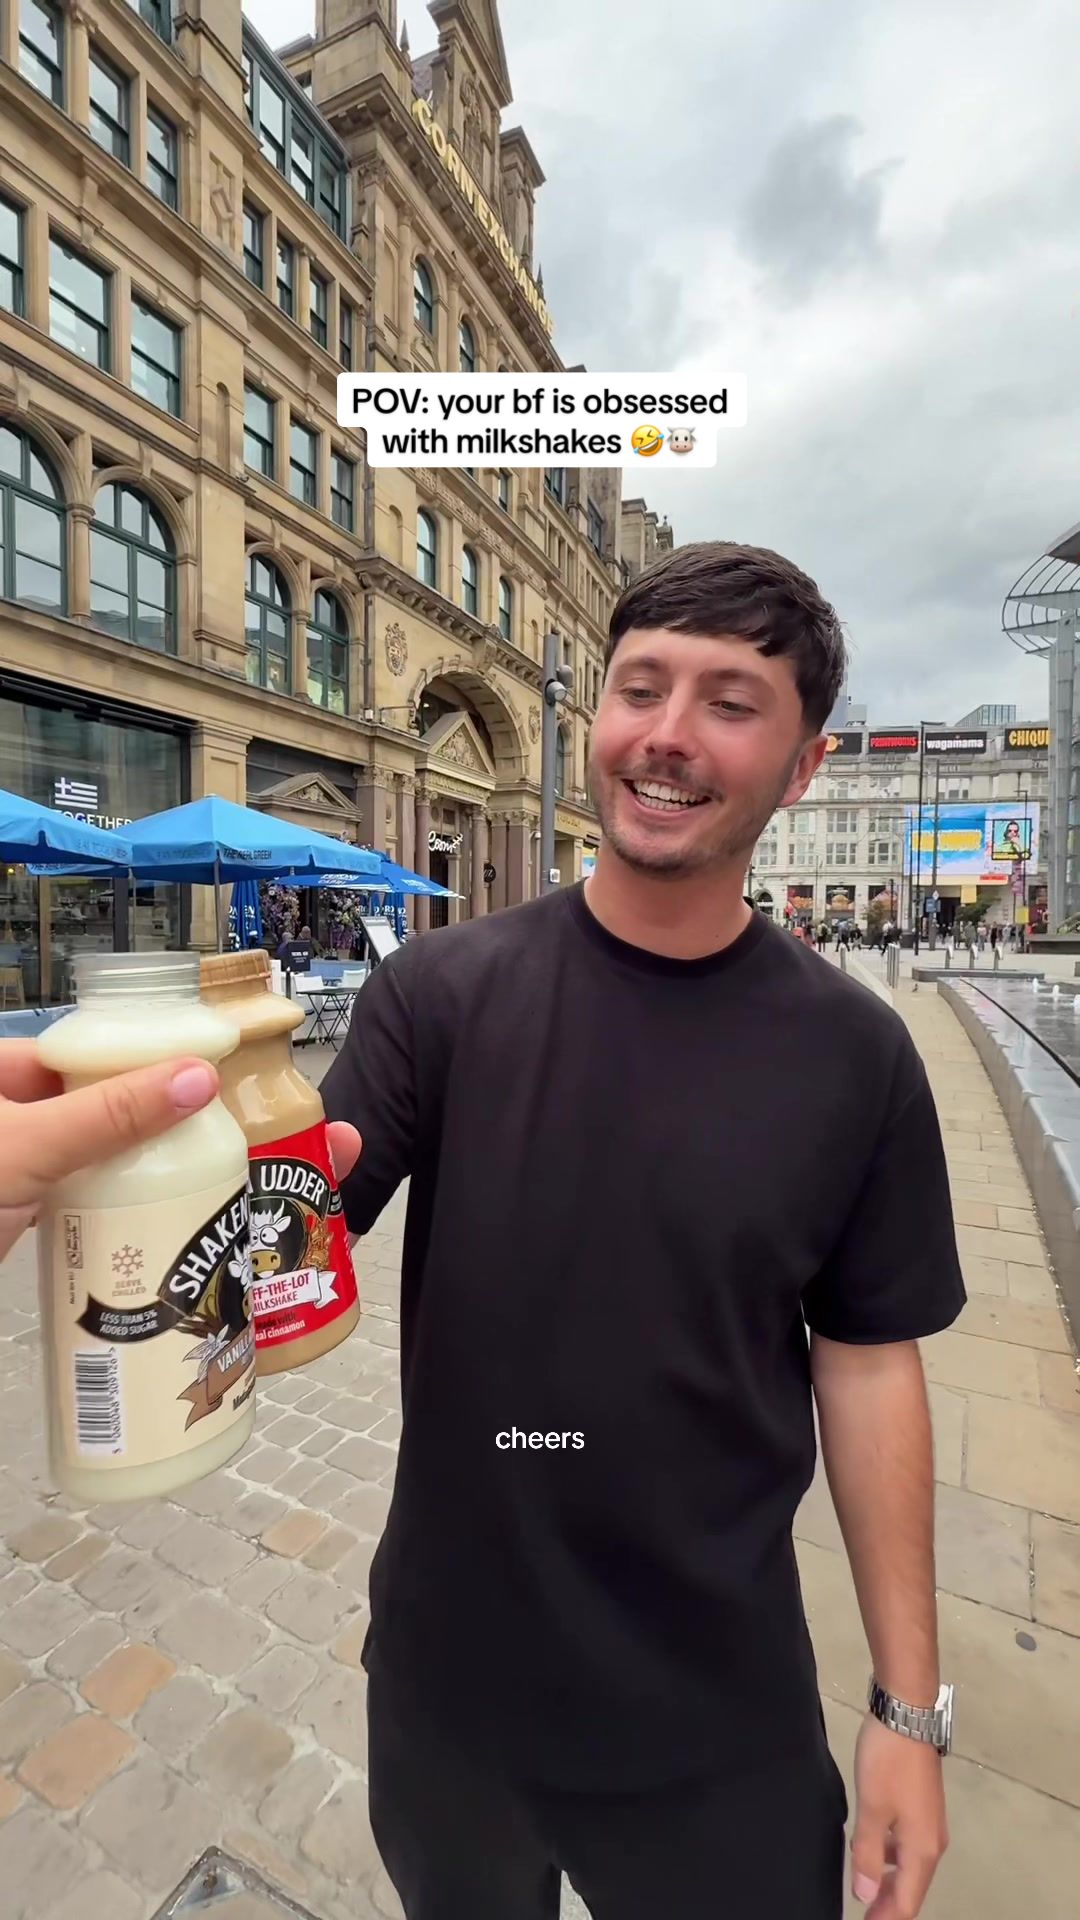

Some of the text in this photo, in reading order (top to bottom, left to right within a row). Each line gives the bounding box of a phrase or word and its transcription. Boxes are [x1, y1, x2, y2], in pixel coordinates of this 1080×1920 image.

[412, 98, 556, 339] CORN EXCHANGE
[926, 737, 984, 751] wagamama
[1008, 729, 1049, 746] CHIQUI
[56, 810, 133, 829] OGETHER
[260, 1164, 326, 1206] UDDER
[112, 1286, 147, 1298] CHILLED
[115, 1280, 142, 1289] SERVE
[252, 1272, 310, 1301] FF-THE-LOT
[100, 1309, 158, 1324] LESS THAN 5%
[100, 1321, 158, 1336] ADDED SUGAR
[255, 1319, 305, 1341] eal cinnamon
[217, 1333, 252, 1373] VANILL
